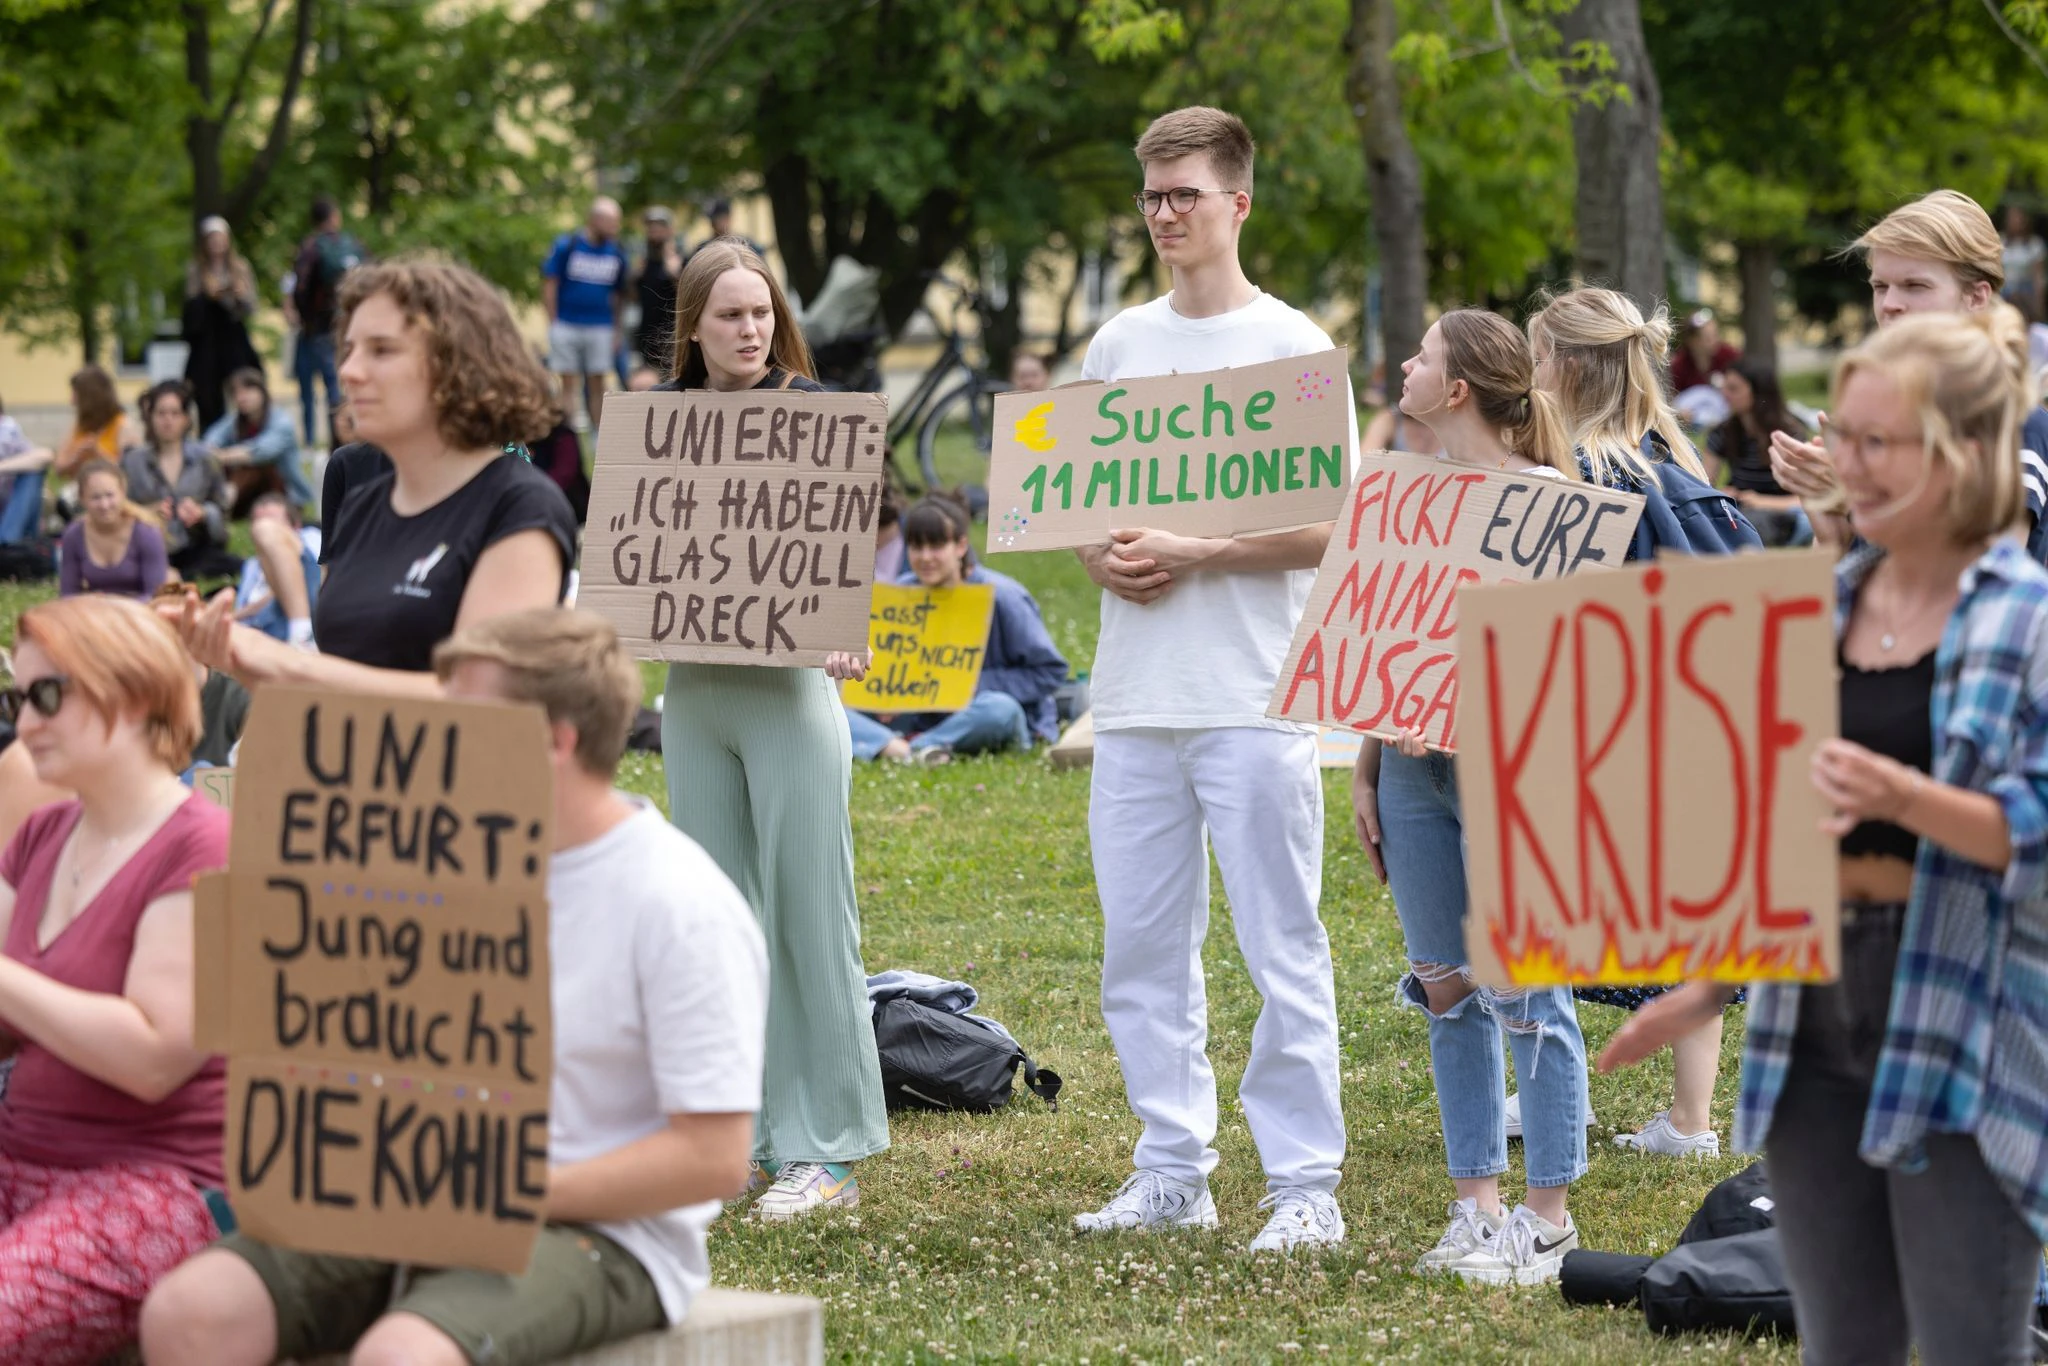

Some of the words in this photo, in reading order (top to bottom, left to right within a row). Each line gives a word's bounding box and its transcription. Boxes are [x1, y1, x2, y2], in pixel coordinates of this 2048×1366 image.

[644, 403, 724, 466] UNI
[734, 406, 880, 469] ERFUT:
[1090, 384, 1276, 446] Suche
[1083, 445, 1342, 509] MILLIONEN
[1347, 470, 1487, 551] FICKT
[613, 534, 732, 586] GLAS
[748, 534, 862, 589] VOLL
[870, 593, 937, 633] asst
[865, 662, 940, 704] allein
[876, 632, 918, 658] uns
[919, 645, 980, 672] NICHT
[304, 704, 459, 793] UNI
[279, 791, 543, 881] ERFURT:
[262, 878, 422, 988] Jung
[441, 905, 533, 980] und
[275, 968, 537, 1084] braucht
